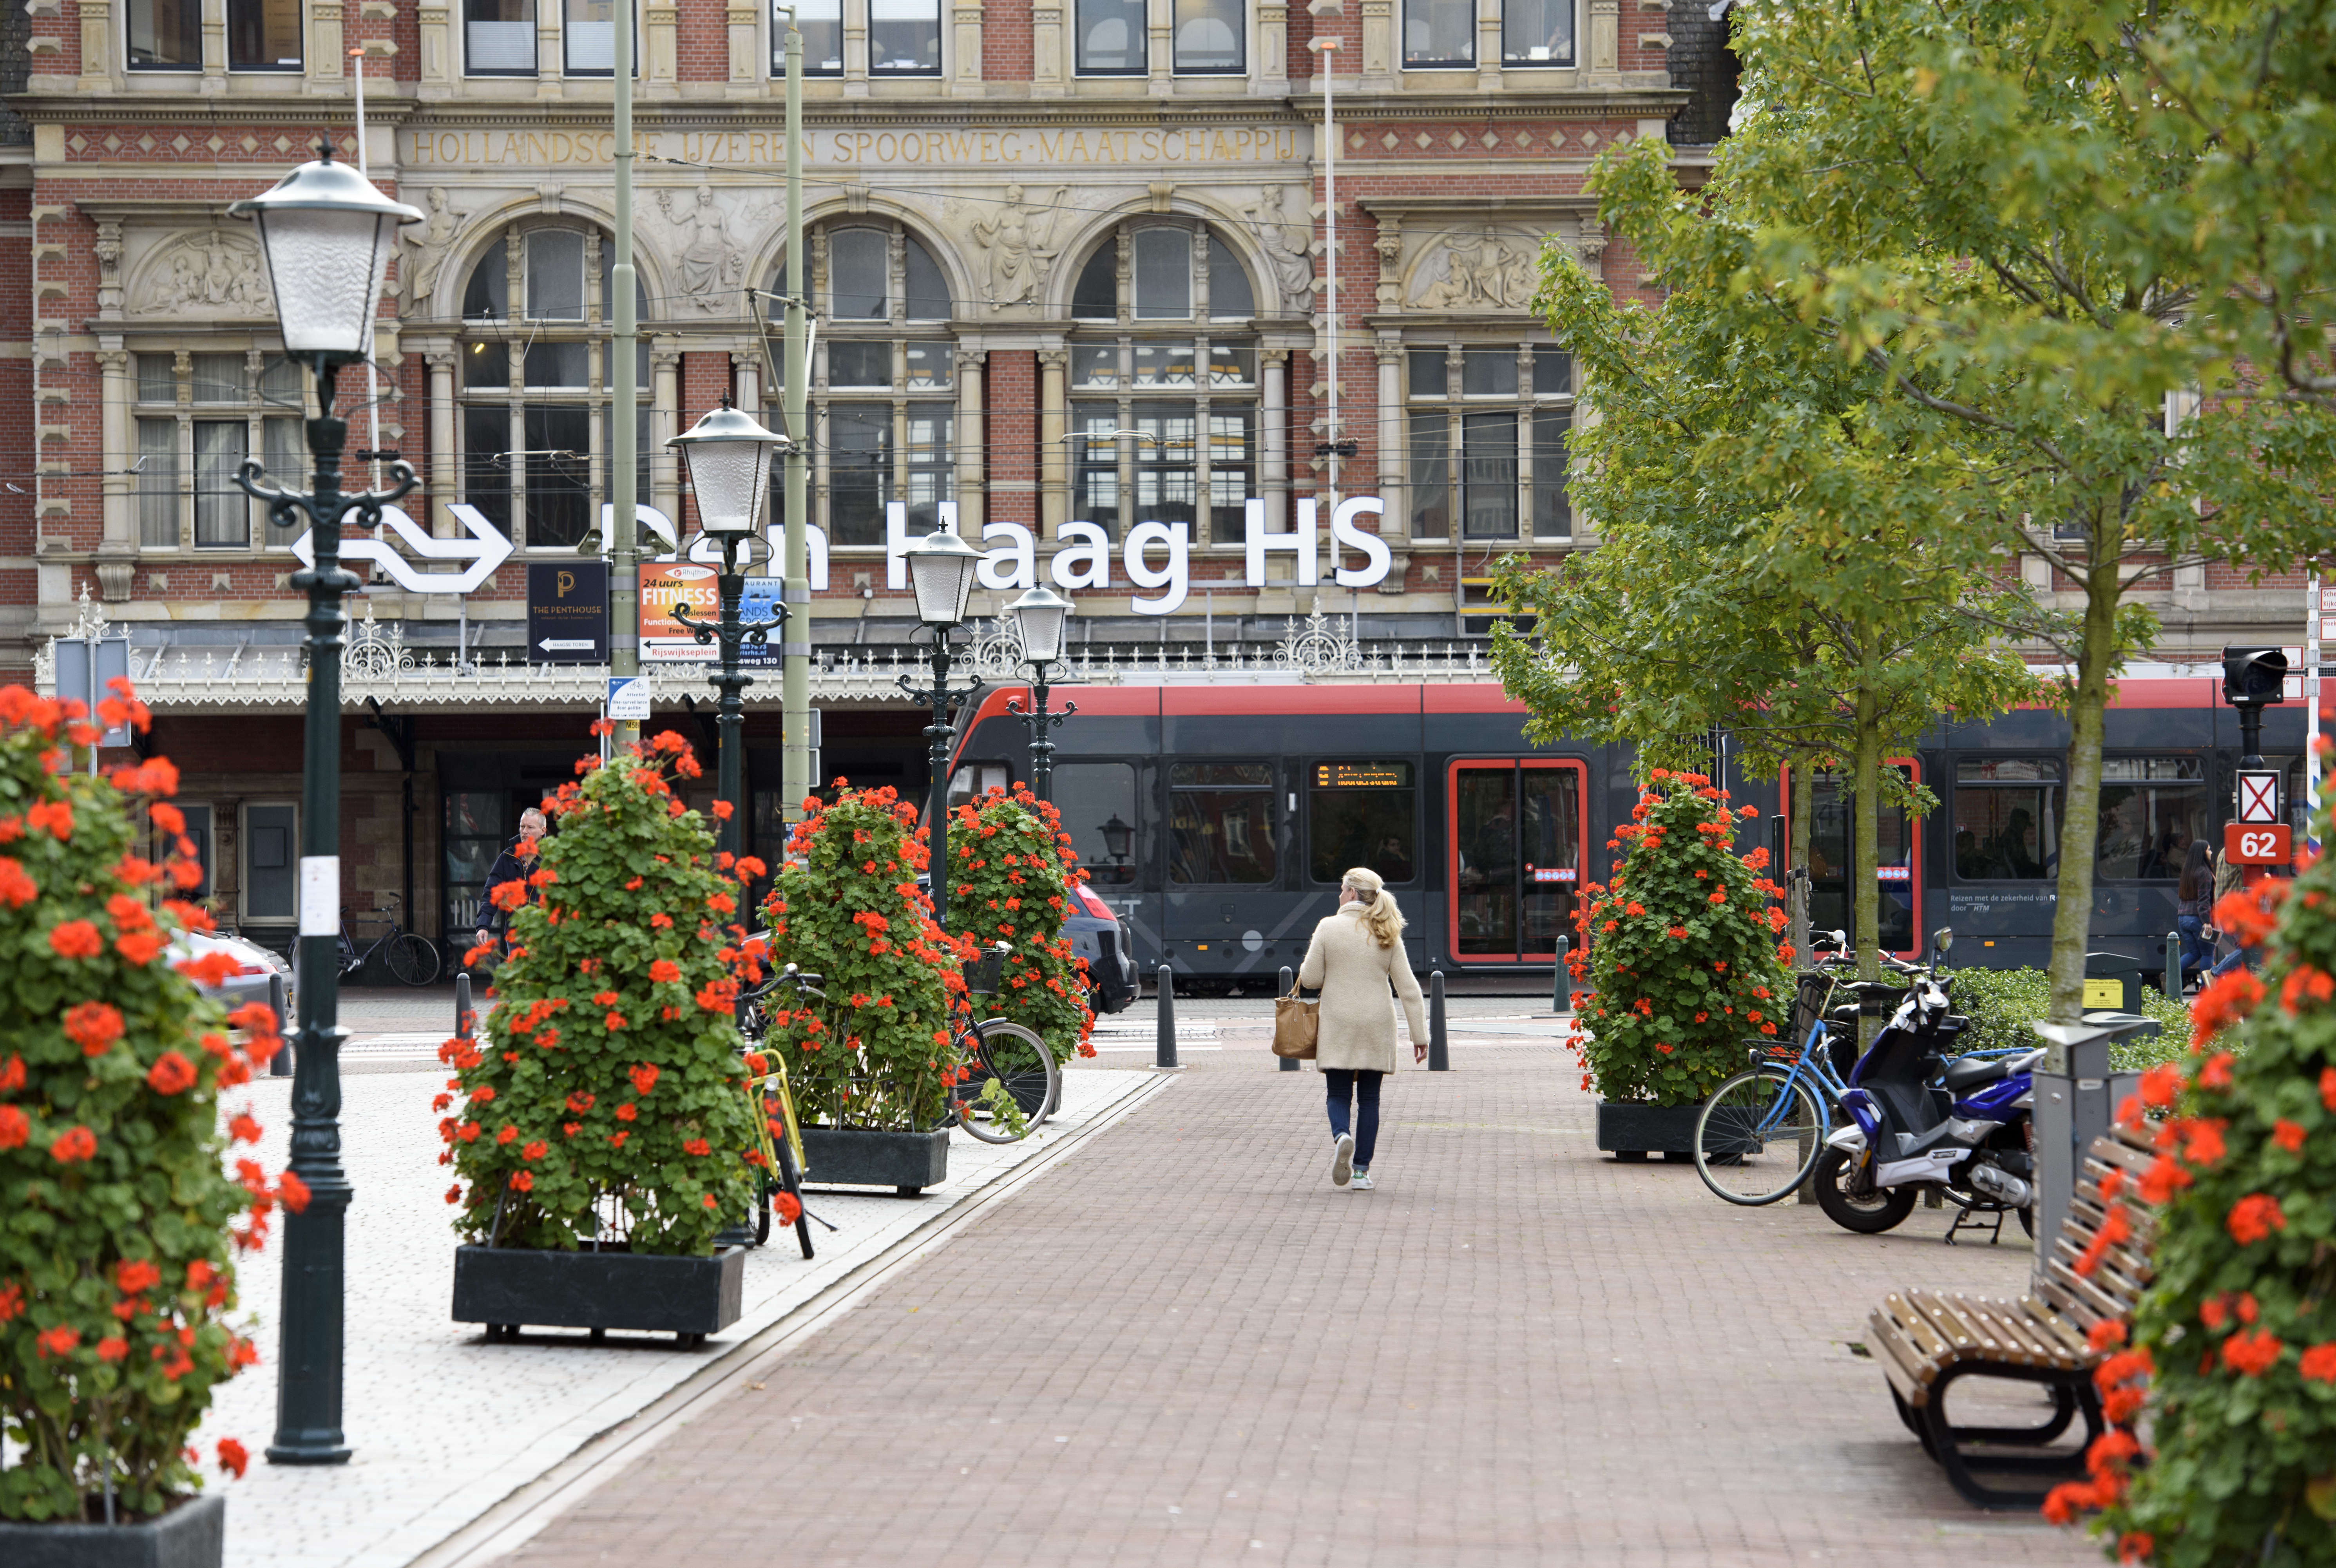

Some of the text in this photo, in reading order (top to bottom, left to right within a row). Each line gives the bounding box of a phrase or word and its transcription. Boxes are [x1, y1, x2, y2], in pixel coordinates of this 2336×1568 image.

[832, 132, 1022, 163] SPOORWEG
[886, 501, 1189, 615] Haag
[1245, 496, 1392, 587] HS
[643, 579, 657, 587] 24
[642, 588, 717, 606] FITNESS
[652, 648, 717, 657] Rijswijkseplein
[2240, 832, 2276, 857] 62
